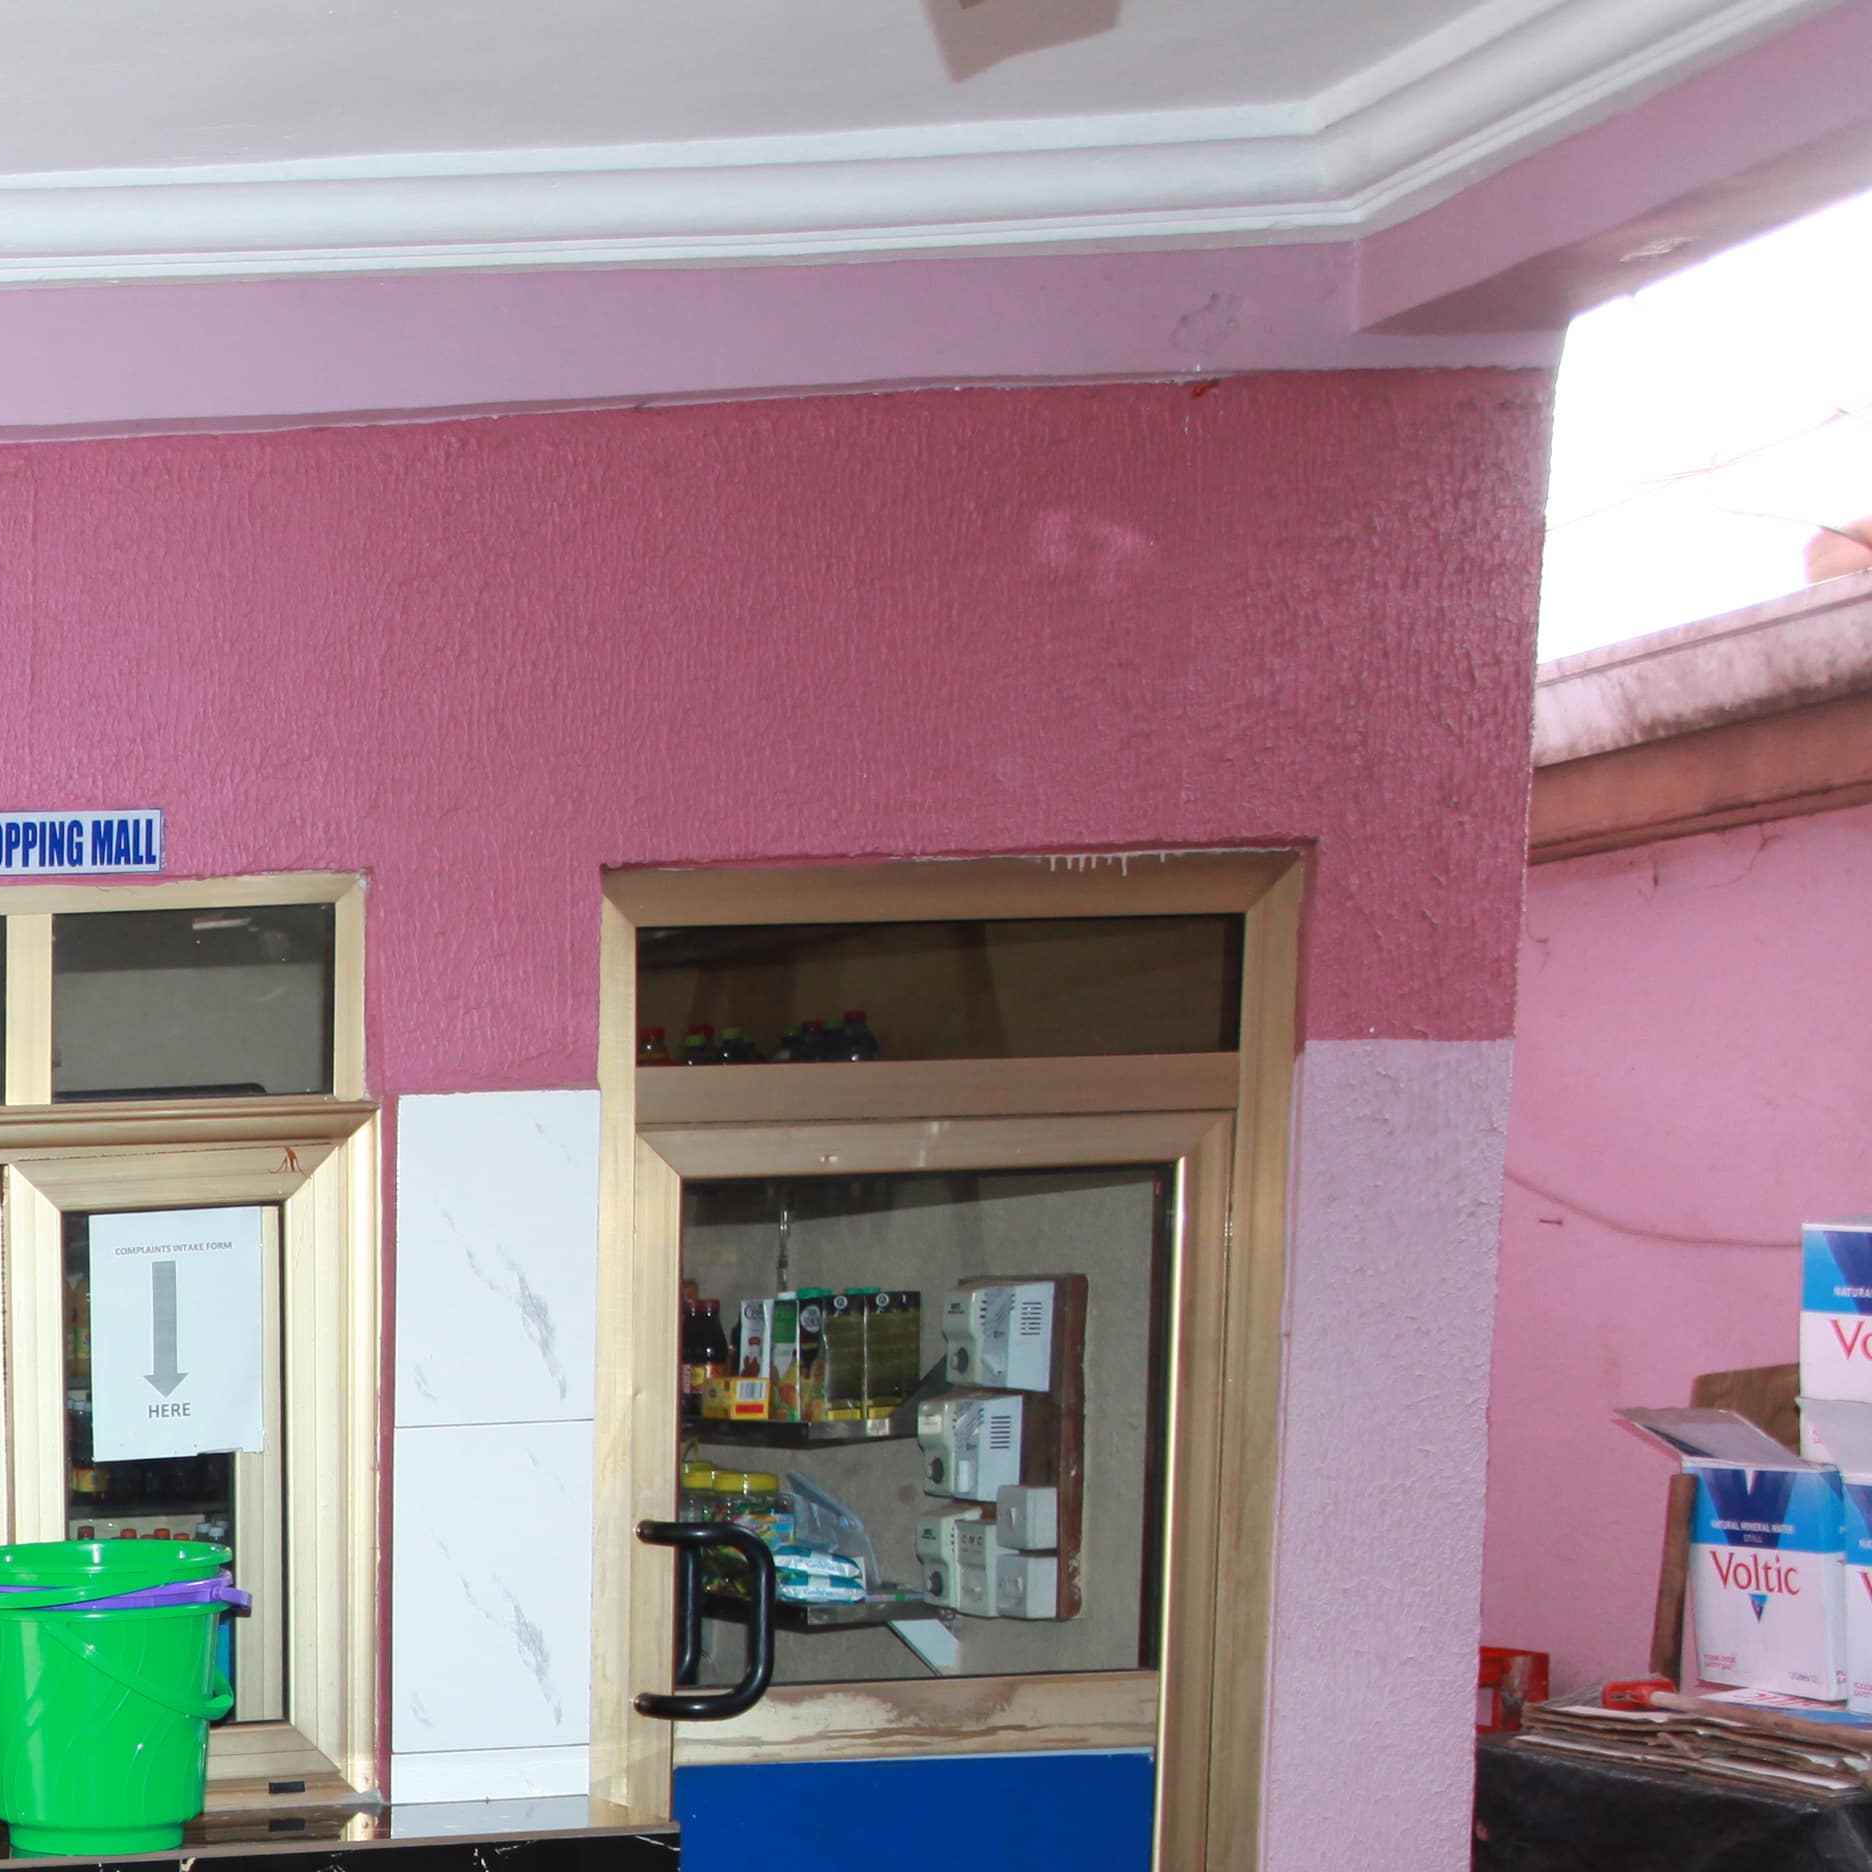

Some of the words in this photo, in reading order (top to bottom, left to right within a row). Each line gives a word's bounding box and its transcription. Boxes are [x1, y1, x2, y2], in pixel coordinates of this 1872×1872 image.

[91, 818, 157, 866] MALL
[115, 1244, 171, 1256] COMPLAINTS
[173, 1242, 203, 1253] INTAKE
[206, 1240, 234, 1251] FORM
[148, 1403, 192, 1419] HERE
[1709, 1550, 1800, 1596] Voltic
